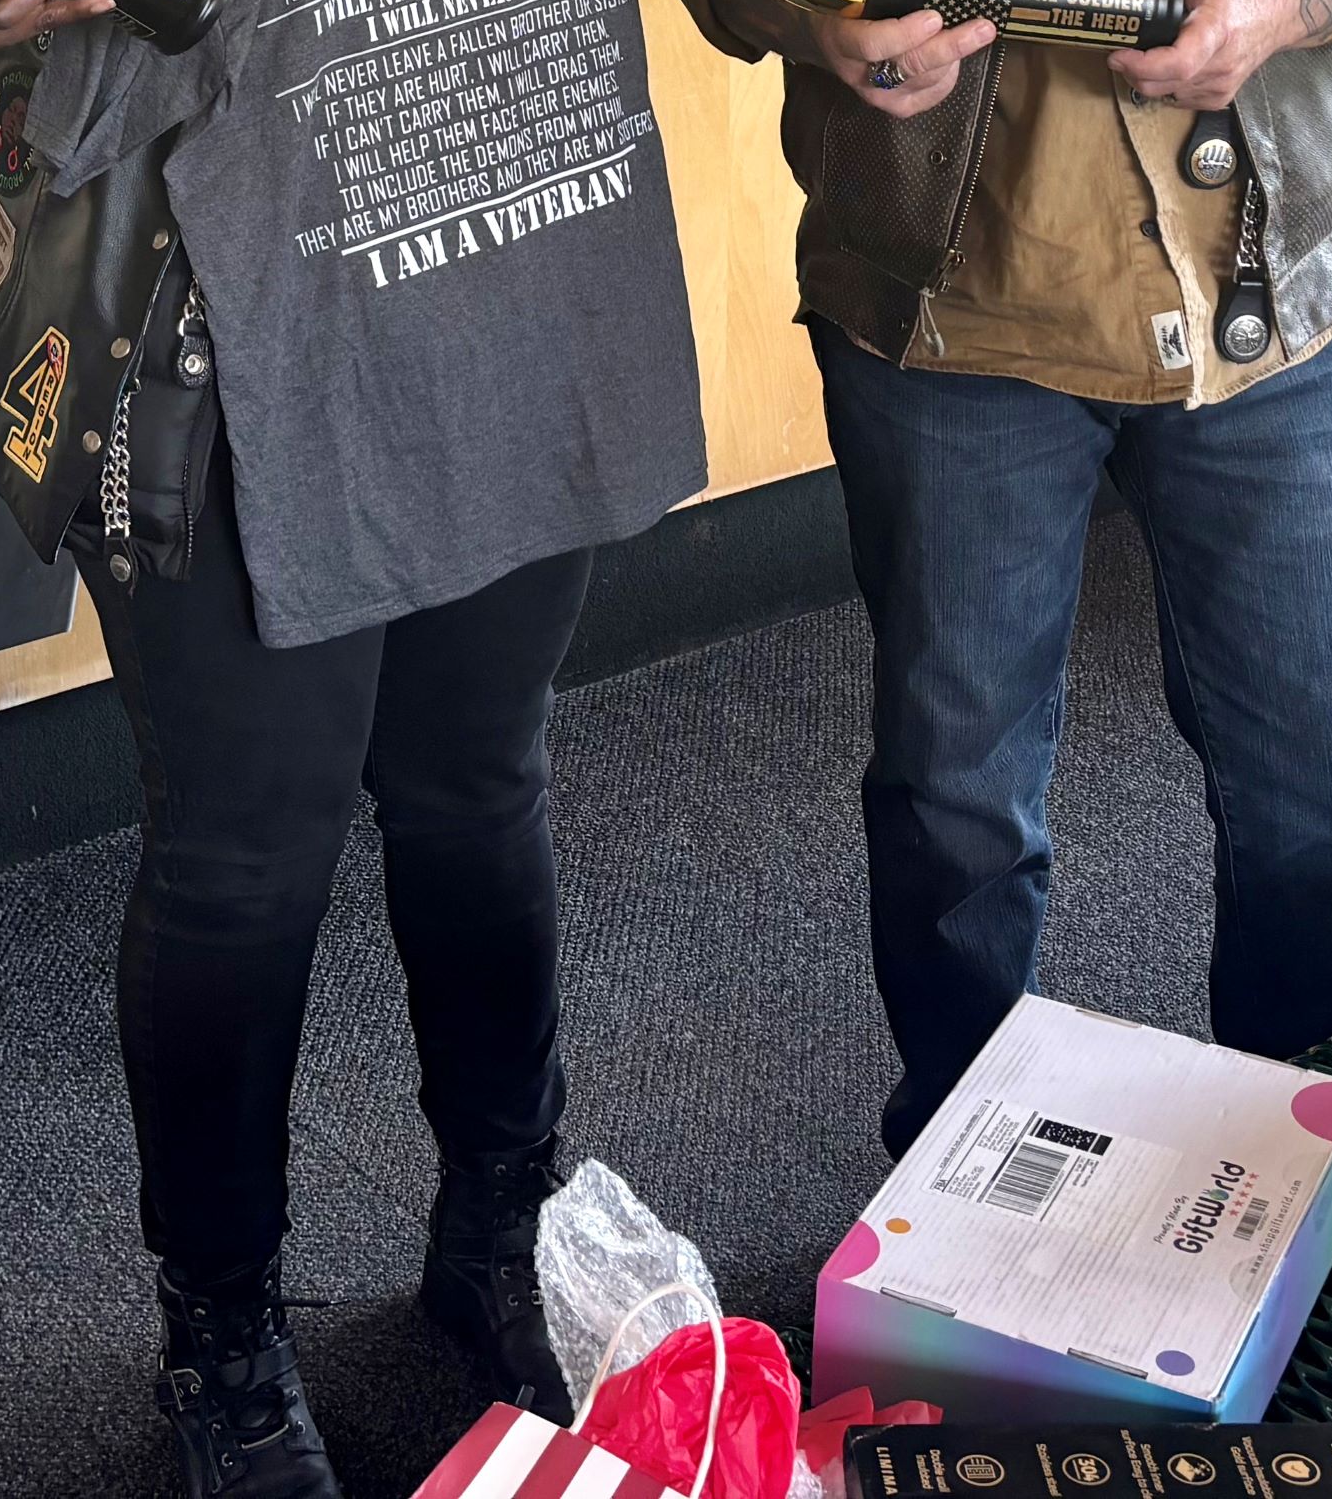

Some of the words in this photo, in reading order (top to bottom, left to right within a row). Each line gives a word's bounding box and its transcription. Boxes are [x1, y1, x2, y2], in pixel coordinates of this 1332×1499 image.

[314, 9, 323, 36] I
[366, 16, 379, 43] I
[1051, 7, 1084, 27] THE
[1091, 13, 1141, 33] HERO
[292, 99, 301, 123] I
[324, 59, 380, 97] NEVER
[382, 42, 433, 79] LEAVE
[437, 38, 448, 62] A
[449, 19, 507, 58] FALLEN
[510, 0, 572, 40] BROTHER
[324, 101, 340, 127] IF
[344, 87, 387, 121] THEY
[394, 76, 424, 108] ARE
[477, 57, 485, 81] I
[487, 47, 521, 77] WILL
[522, 28, 569, 65] CARRY
[573, 18, 609, 49] THEM.
[314, 134, 330, 160] IF
[334, 130, 342, 155] I
[345, 114, 394, 151] CAN'T
[399, 95, 451, 135] CARRY
[514, 66, 545, 96] WILL
[547, 52, 588, 85] DRAG
[589, 40, 624, 71] THEM.
[334, 161, 341, 184] I
[343, 149, 386, 181] WILL
[388, 134, 430, 167] HELP
[433, 119, 478, 152] THEM
[481, 105, 519, 137] FACE
[519, 90, 559, 124] THEIR
[562, 70, 620, 109] ENEMIES.
[339, 184, 365, 212] TO
[366, 160, 438, 205] INCLUDE
[440, 149, 472, 179] THE
[475, 127, 534, 169] DEMONS
[535, 112, 577, 147] FROM
[295, 222, 337, 258] THEY
[343, 210, 376, 243] ARE
[377, 201, 401, 230] MY
[406, 172, 492, 220] BROTHERS
[496, 161, 523, 192] AND
[524, 145, 558, 179] THEY
[564, 135, 593, 165] ARE
[594, 127, 615, 152] MY
[367, 250, 389, 288] I
[398, 228, 449, 280] AM
[457, 219, 481, 258] A
[483, 160, 633, 246] VETERAN!
[23, 377, 54, 460] REGION
[876, 1446, 898, 1497] LIMIMA
[915, 1454, 934, 1490] insulated
[929, 1449, 944, 1476] Double
[938, 1474, 951, 1493] wall
[1035, 1443, 1054, 1478] Stainless
[1047, 1477, 1063, 1498] steel
[1078, 1457, 1101, 1482] 304
[1120, 1428, 1138, 1459] surface
[1130, 1458, 1145, 1479] Easy
[1140, 1443, 1158, 1470] Smooth
[1151, 1470, 1164, 1494] inner
[1230, 1446, 1246, 1469] Gold
[1238, 1469, 1256, 1496] surface
[1242, 1436, 1258, 1464] Vacuum
